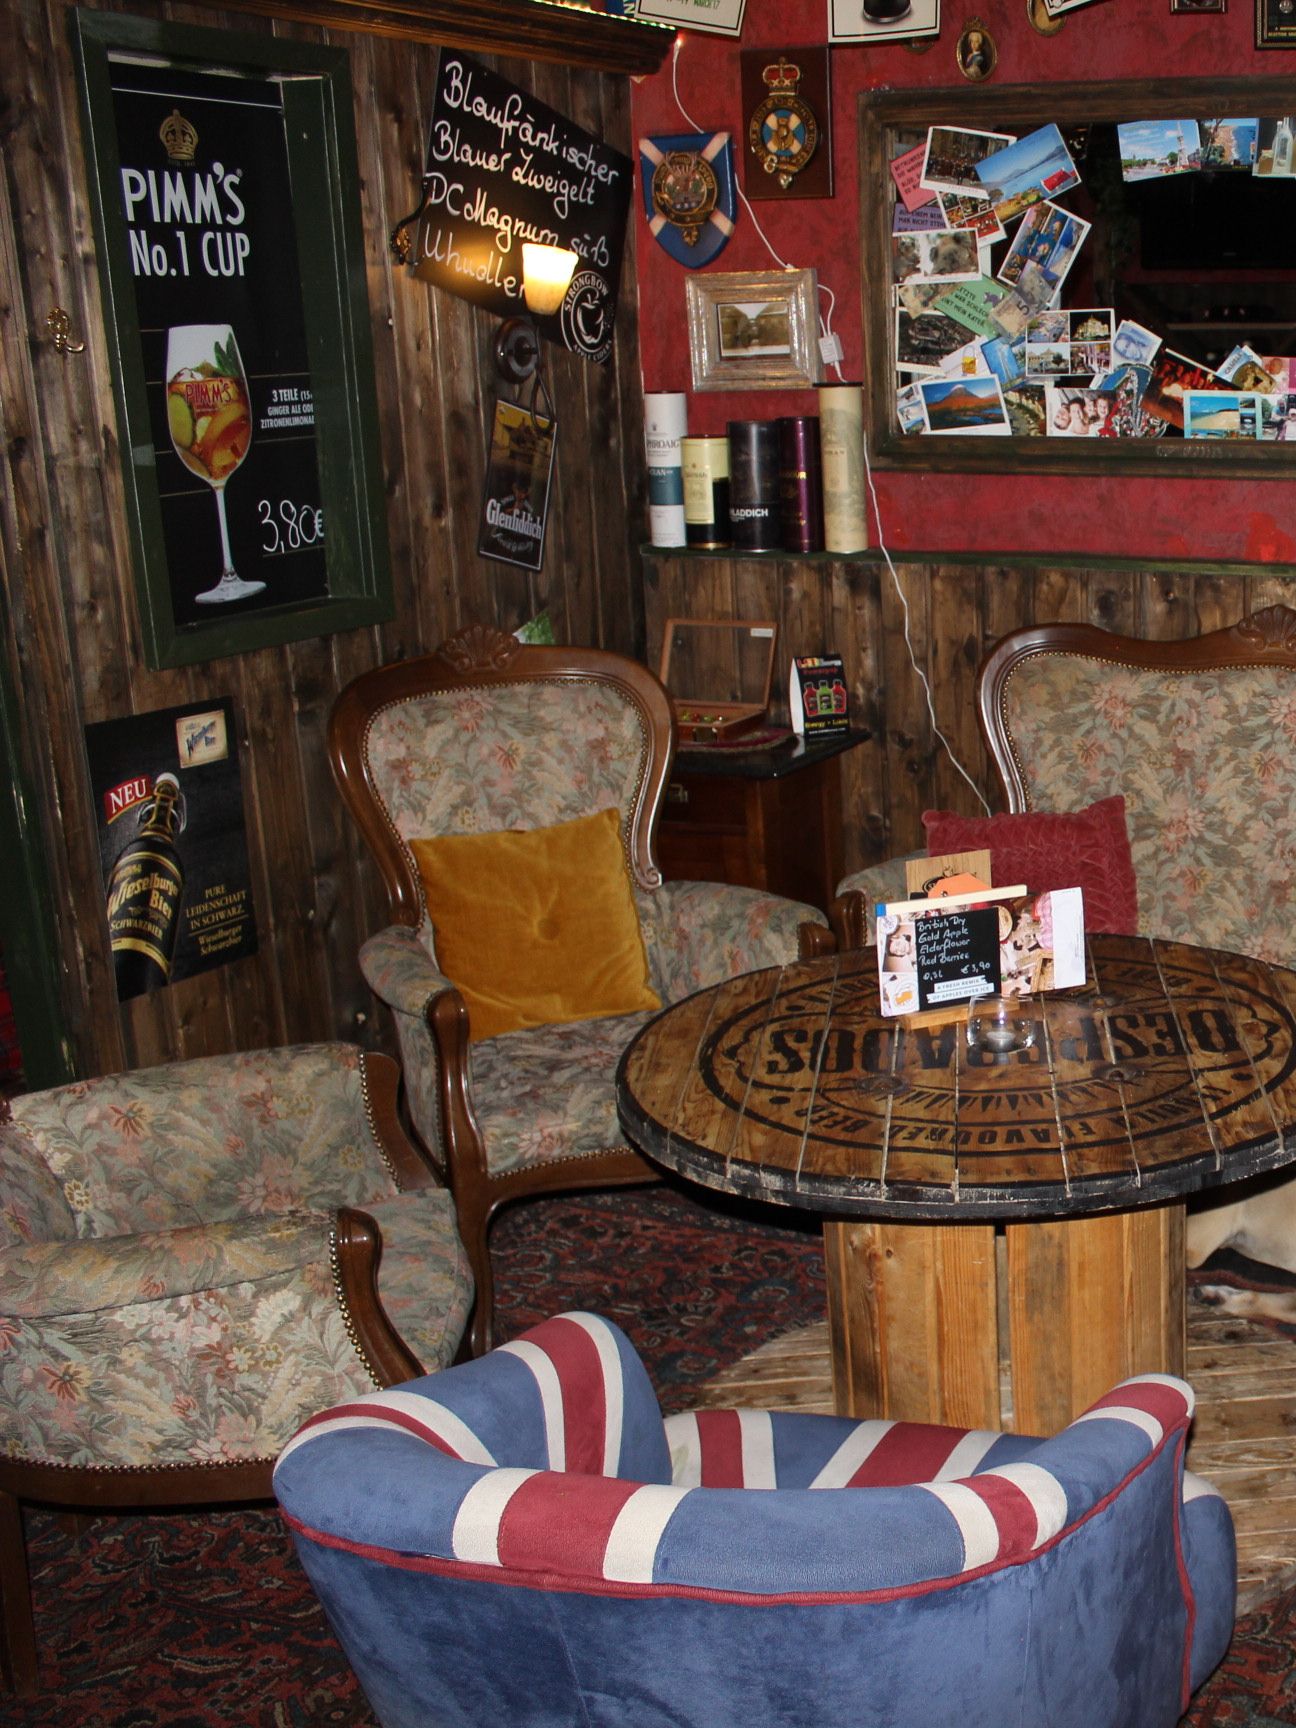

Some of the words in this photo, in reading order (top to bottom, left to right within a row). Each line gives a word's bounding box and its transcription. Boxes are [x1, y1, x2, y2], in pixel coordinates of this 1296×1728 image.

[443, 61, 620, 187] Blaufränkischer
[432, 120, 512, 174] Blauer
[511, 148, 596, 221] Zweigelt
[121, 162, 246, 226] PIMM'S
[463, 188, 560, 254] Magnum
[202, 231, 251, 277] CUP
[564, 274, 609, 313] STRONGBOW
[1016, 301, 1030, 317] 5
[272, 390, 279, 402] 3
[279, 388, 299, 401] TEILE
[267, 406, 291, 416] GINGER
[291, 406, 303, 415] ALE
[486, 498, 542, 540] Glenfiddich
[108, 778, 148, 815] NEU
[106, 873, 178, 919] Wieselburger
[149, 890, 173, 921] Bier
[185, 890, 247, 918] LEIDENSCHAFT
[205, 884, 226, 899] PURE
[109, 918, 163, 940] SCHWARZBIER
[190, 919, 201, 930] IN
[916, 917, 949, 933] British
[949, 915, 967, 927] Dry
[918, 930, 940, 944] Gold
[942, 926, 969, 940] Apple
[919, 938, 971, 956] Elderflower
[793, 1102, 873, 1134] BEER
[880, 1119, 1097, 1146] FLAVOURED
